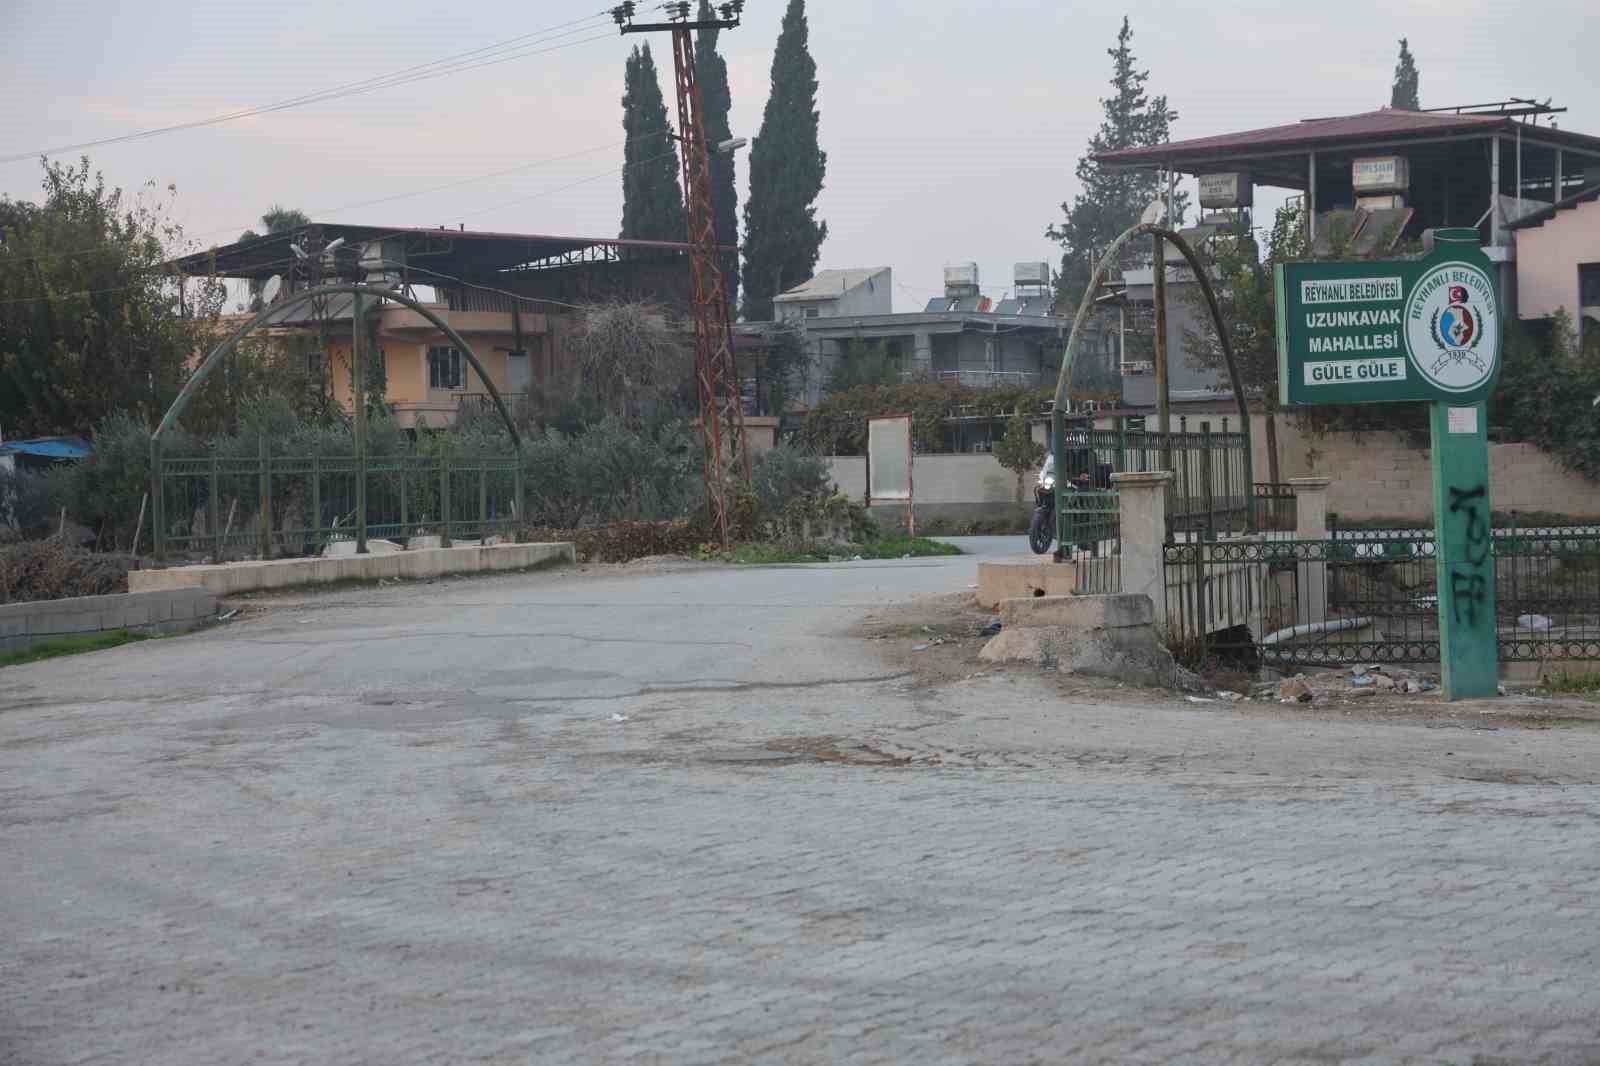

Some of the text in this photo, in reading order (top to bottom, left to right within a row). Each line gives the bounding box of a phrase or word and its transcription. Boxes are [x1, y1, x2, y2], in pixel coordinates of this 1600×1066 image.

[1305, 280, 1399, 301] REYHANLI BELEDİYESİ
[1306, 309, 1401, 328] UZUNKAVAK
[1309, 330, 1399, 352] MAHALLESİ
[1312, 360, 1398, 380] GÜLE GÜLE
